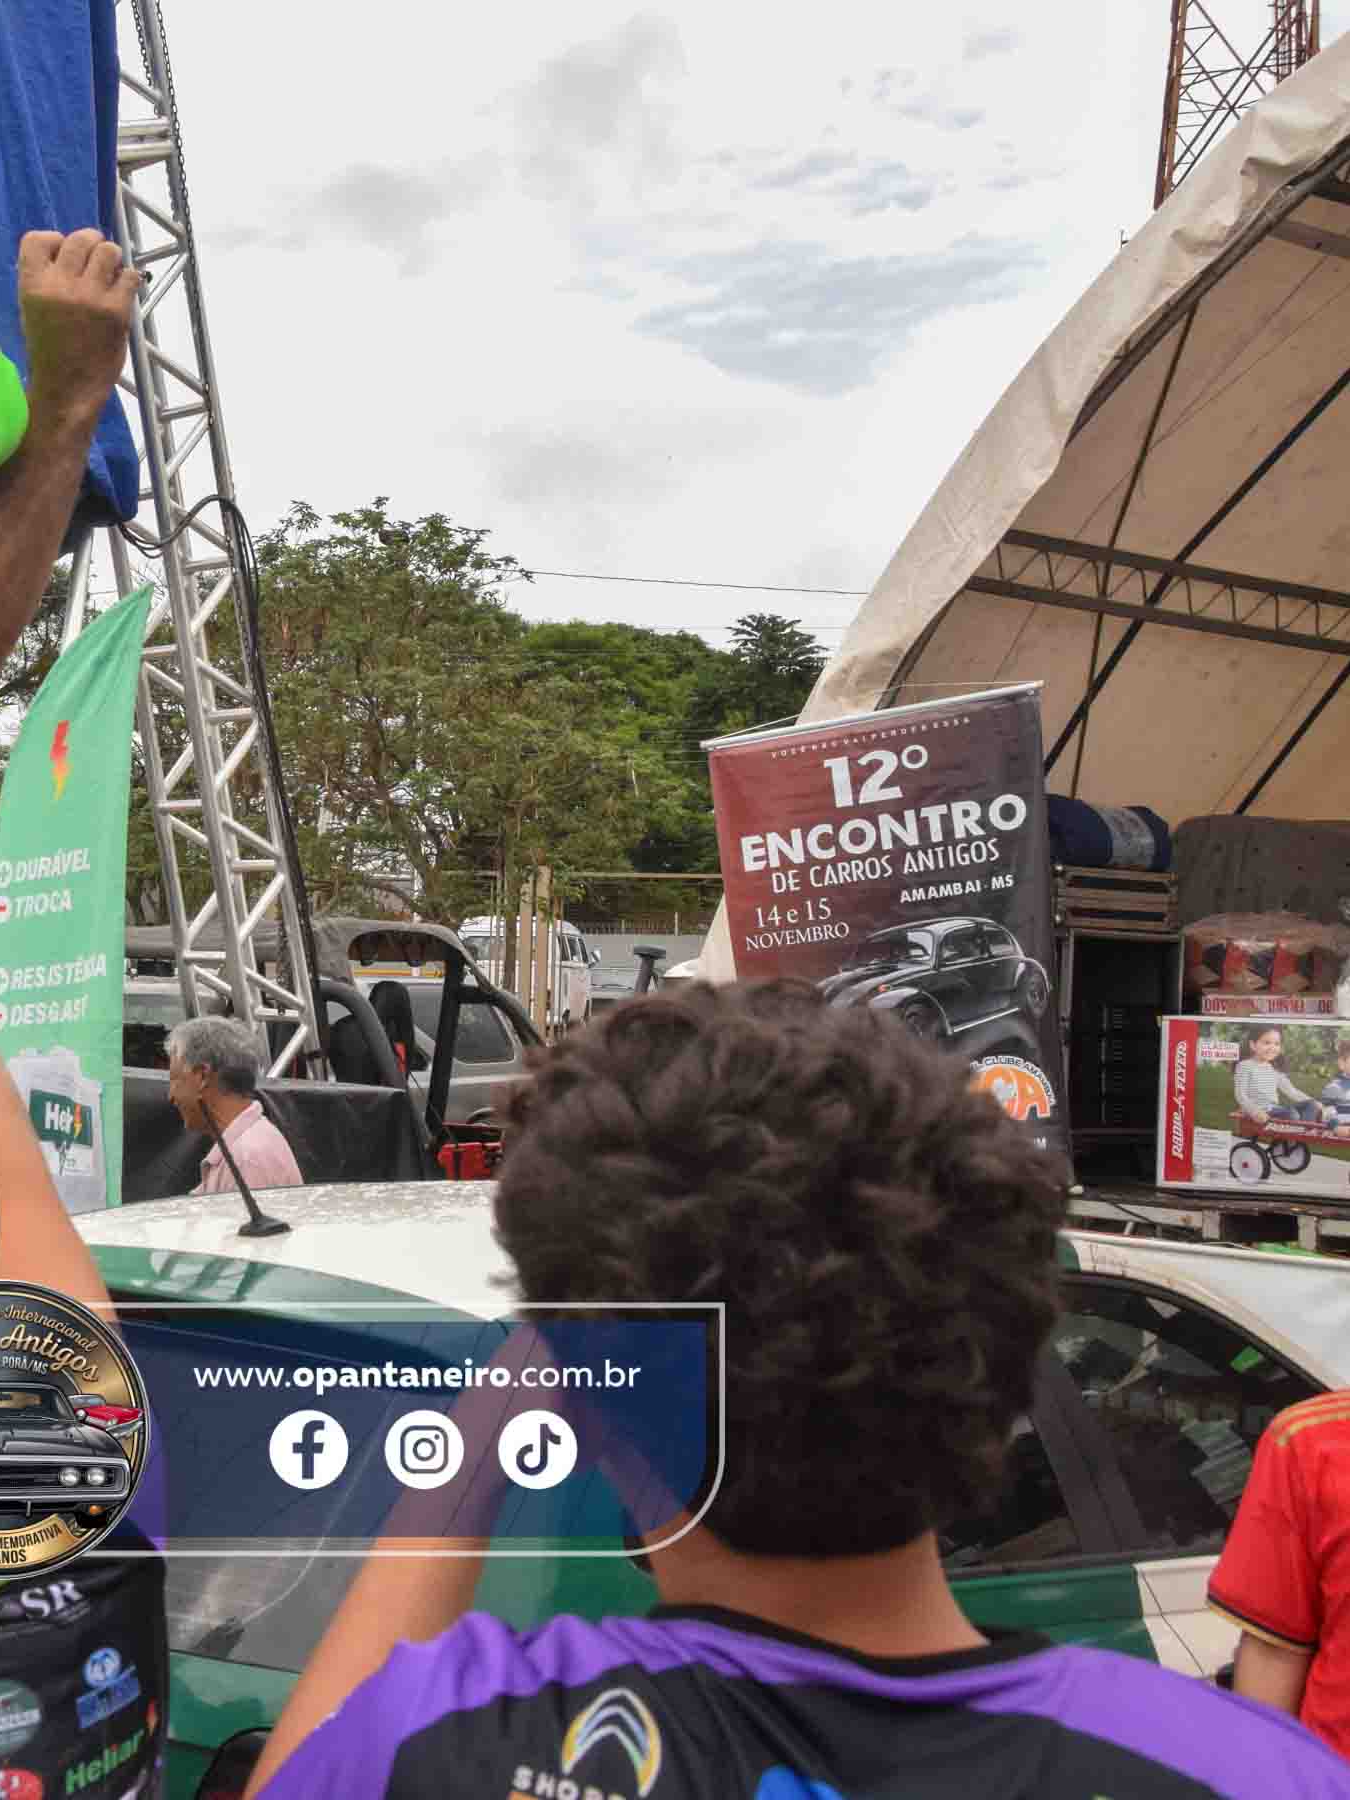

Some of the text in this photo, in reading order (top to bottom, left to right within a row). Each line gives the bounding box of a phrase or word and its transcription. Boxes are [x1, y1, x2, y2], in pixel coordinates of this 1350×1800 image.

[740, 793, 1027, 872] ENCONTRO
[771, 837, 1000, 894] DE CARROS ANTIGOS
[900, 873, 1014, 904] AMAMBAI MS
[754, 897, 833, 929] 14 e 15
[745, 921, 850, 952] NOVEMBRO
[20, 1579, 82, 1618] SR
[66, 1729, 145, 1794] Heliar
[512, 1765, 627, 1800] SHO
